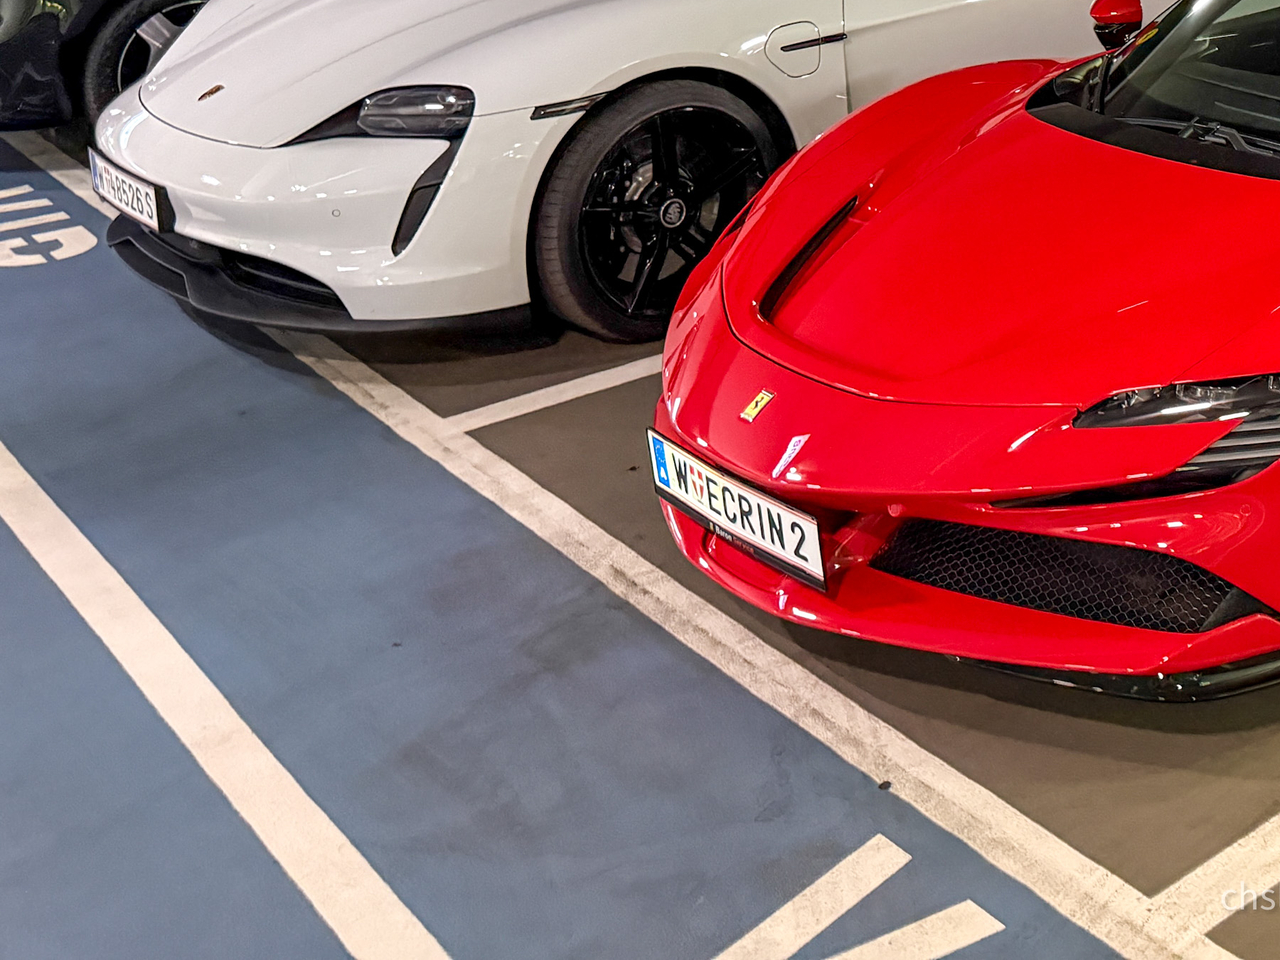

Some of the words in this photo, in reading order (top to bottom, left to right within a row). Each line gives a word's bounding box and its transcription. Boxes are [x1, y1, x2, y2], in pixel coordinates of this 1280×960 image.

[110, 172, 144, 215] 48526
[145, 191, 154, 220] S
[672, 452, 689, 495] W
[705, 475, 786, 551] ECRIN
[790, 521, 809, 563] 2
